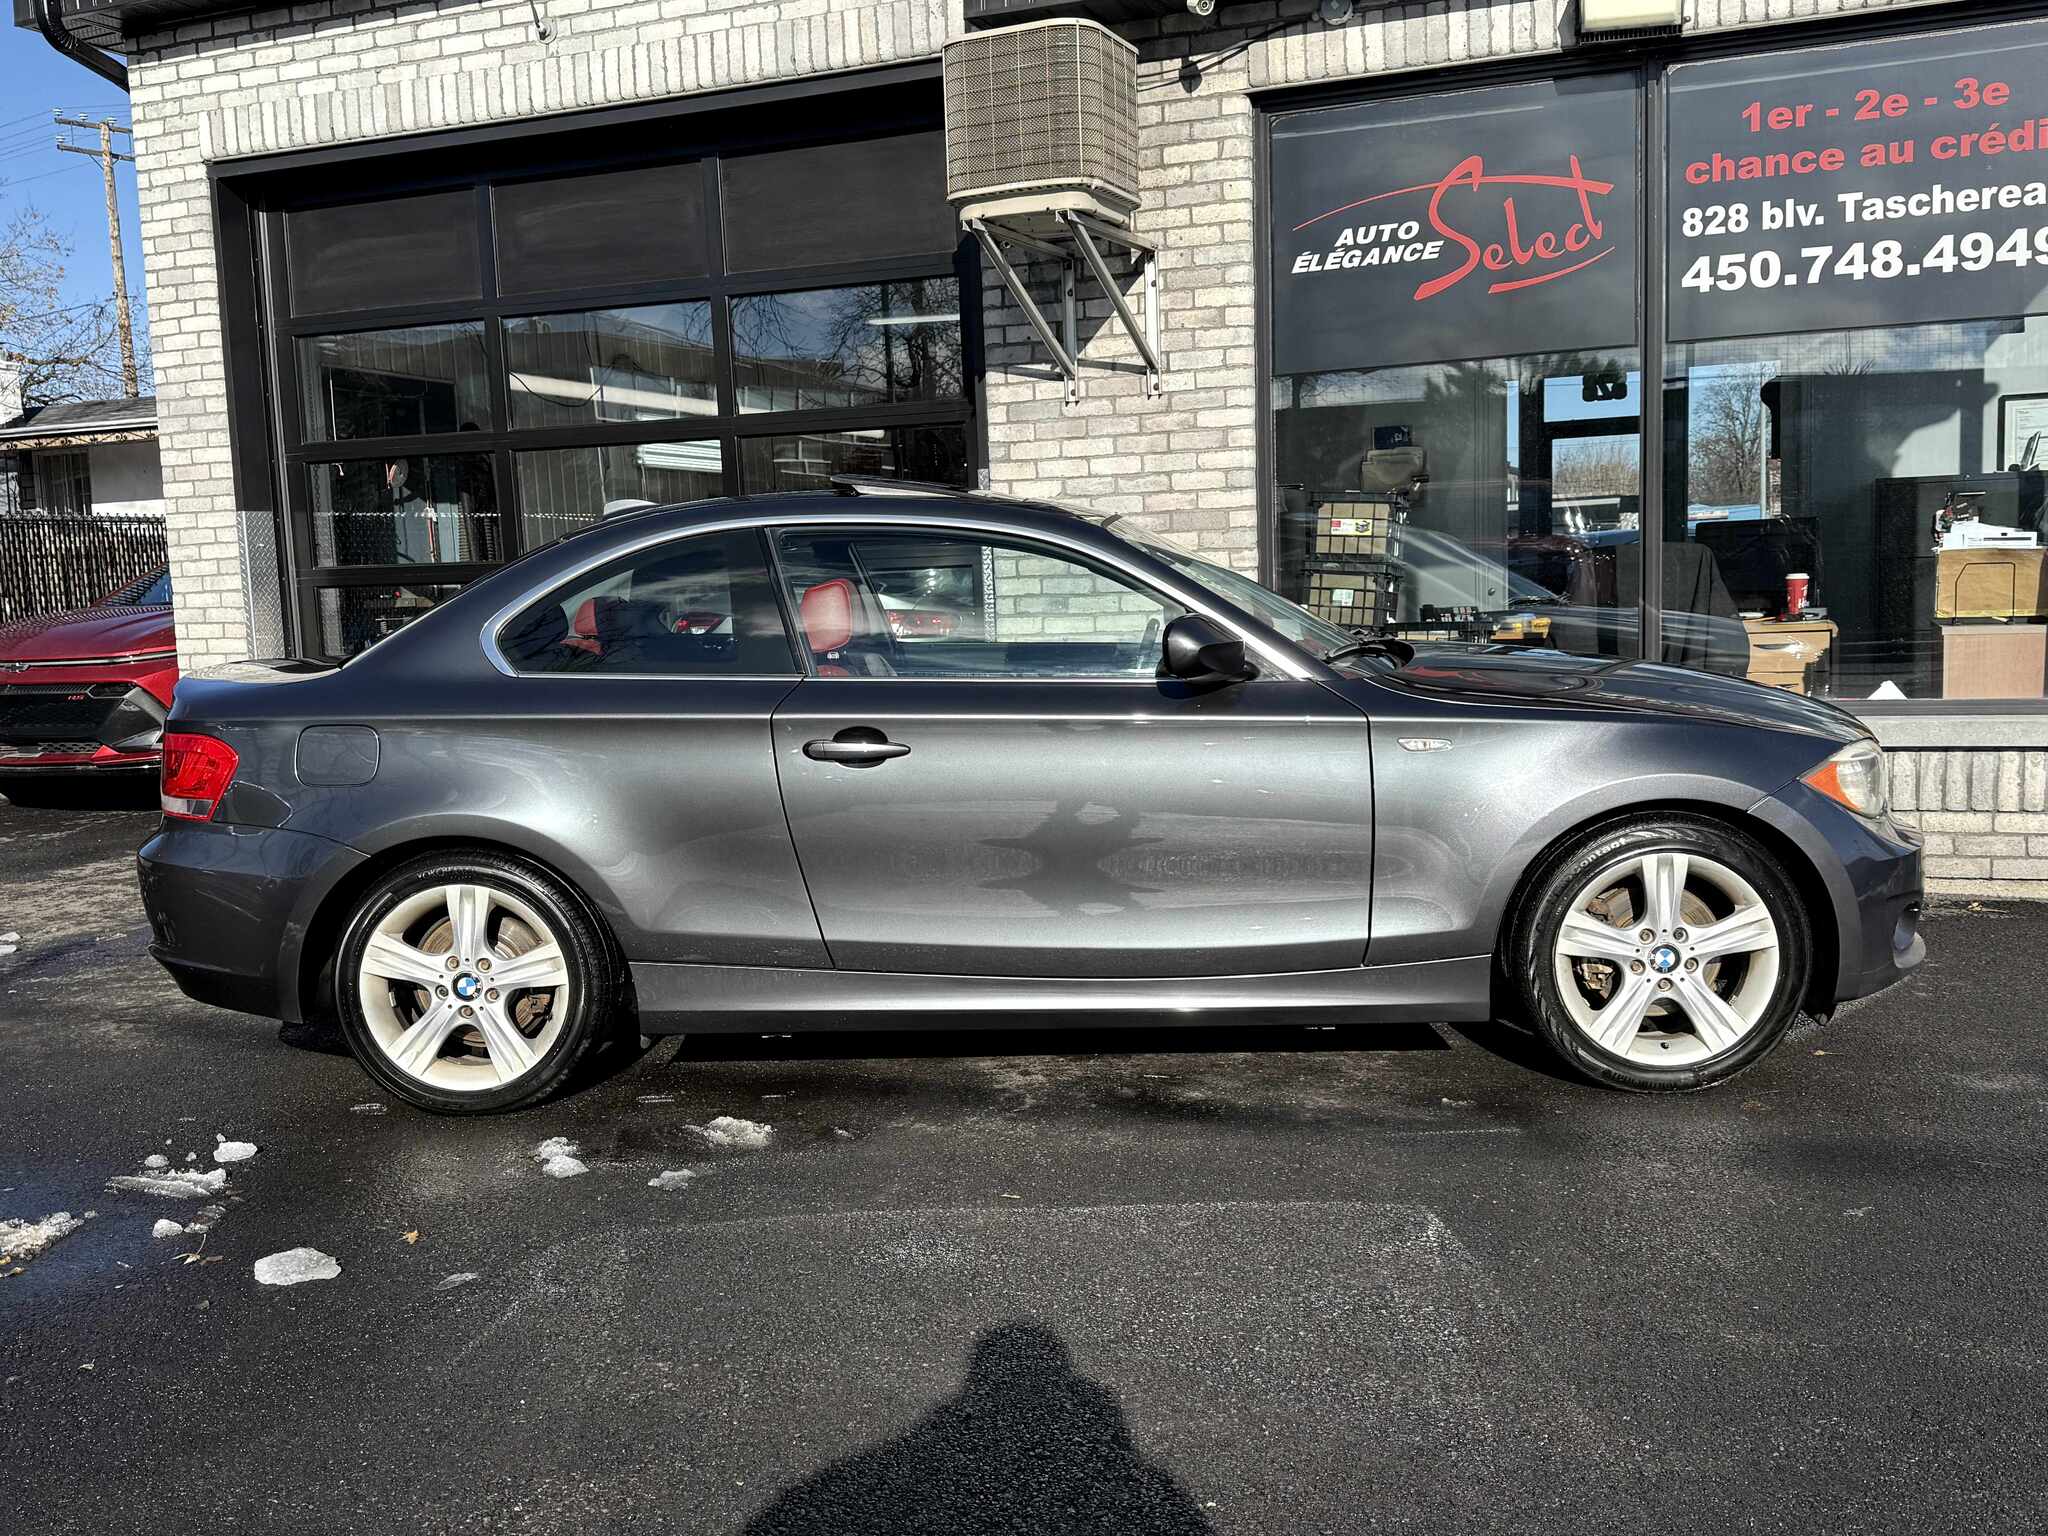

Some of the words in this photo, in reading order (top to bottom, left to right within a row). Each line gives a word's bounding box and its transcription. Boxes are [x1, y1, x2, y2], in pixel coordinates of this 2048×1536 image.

[1742, 101, 1814, 132] 1er
[1825, 107, 1840, 117] -
[1854, 89, 1910, 120] 2e
[1923, 96, 1938, 106] -
[1953, 76, 2010, 109] 3e
[1685, 148, 1845, 185] chance
[1859, 140, 1915, 167] au
[1414, 154, 1614, 300] Select
[1682, 202, 1749, 237] 828
[1762, 198, 1825, 230] blv.
[1837, 181, 2048, 223] Tascherea
[1291, 240, 1444, 274] ÉLÉGANCE
[1334, 220, 1420, 249] AUTO
